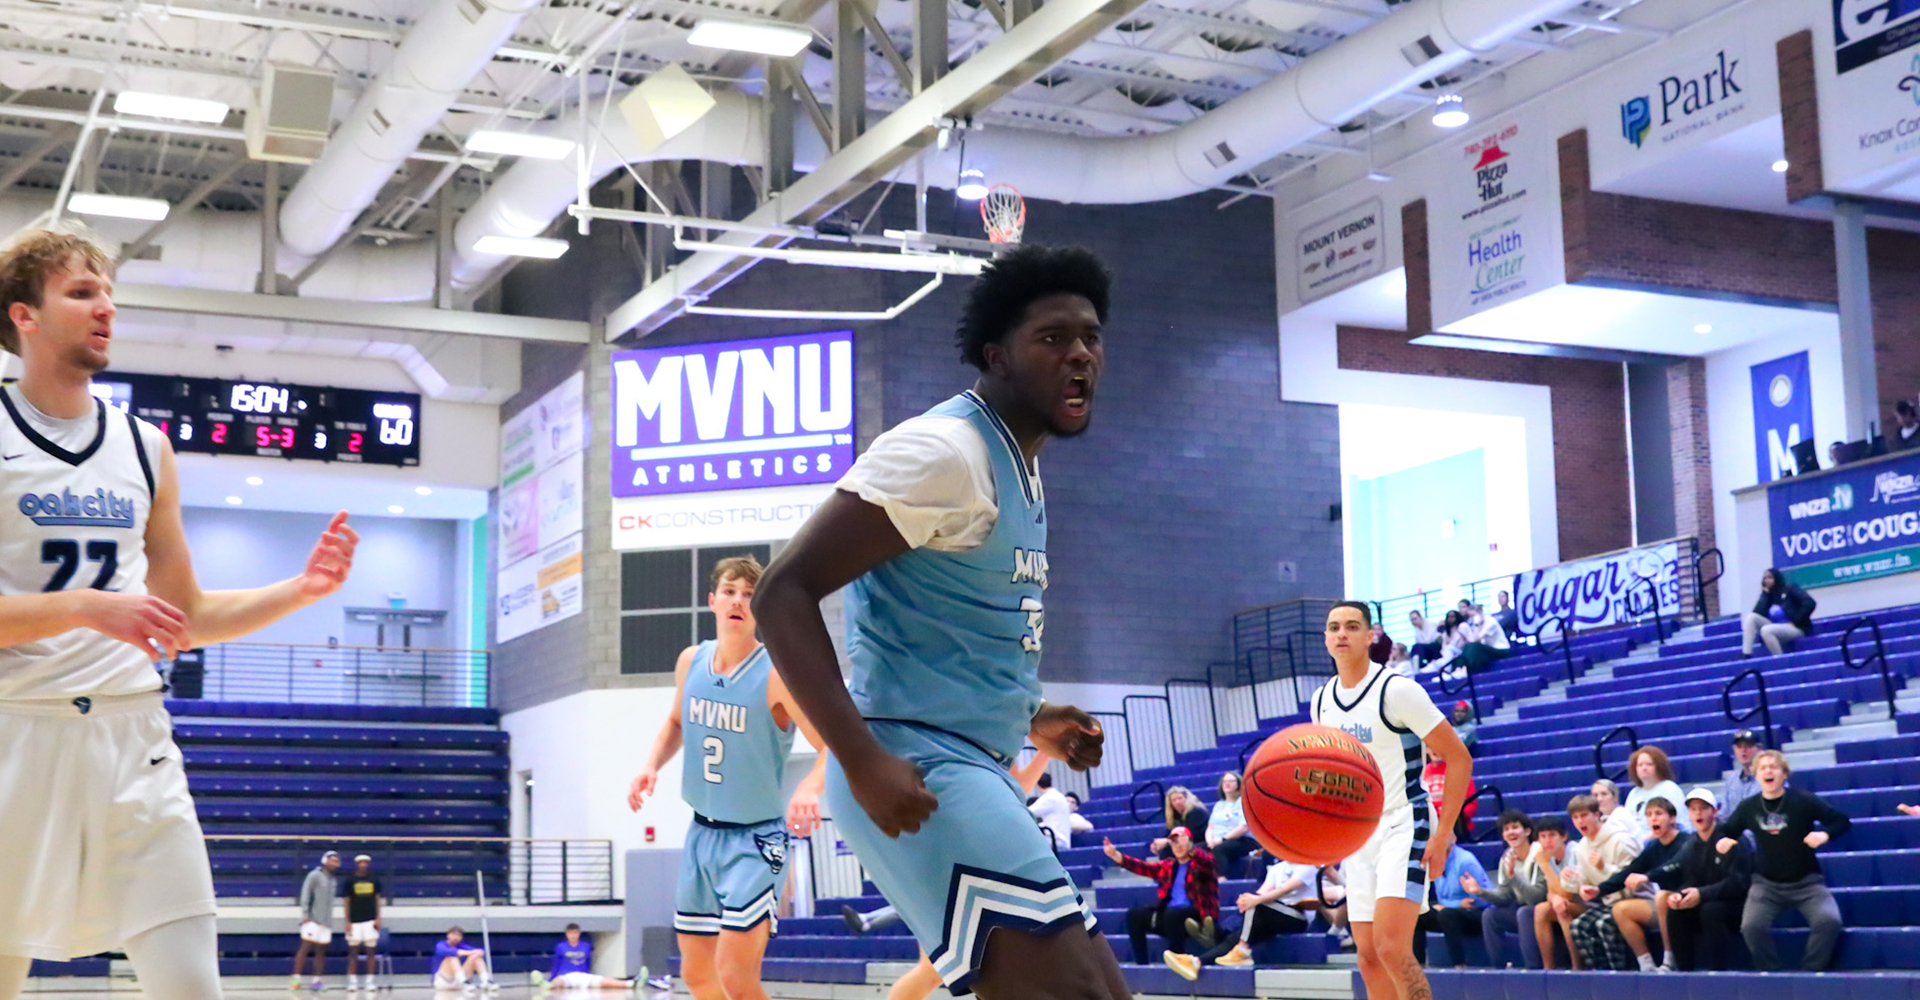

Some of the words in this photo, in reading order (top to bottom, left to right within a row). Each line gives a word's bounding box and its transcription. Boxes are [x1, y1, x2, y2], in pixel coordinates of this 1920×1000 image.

[1659, 50, 1743, 126] Park
[1859, 127, 1893, 151] Knox
[1477, 162, 1508, 188] Pizza
[1479, 181, 1503, 201] Hut
[1303, 231, 1335, 255] MOUNT
[1337, 214, 1375, 240] VERNON
[1469, 229, 1522, 267] Health
[1476, 254, 1525, 291] Center
[614, 340, 852, 447] MVNU
[179, 423, 193, 441] 3
[211, 423, 228, 444] 2
[314, 432, 327, 449] 3
[348, 432, 363, 453] 2
[379, 419, 413, 446] 60
[632, 453, 832, 486] ATHLETICS
[18, 486, 135, 529] oakcity
[1780, 525, 1846, 558] VOICE
[1852, 511, 1920, 544] COUG
[1513, 560, 1626, 637] Cougar
[688, 696, 748, 734] MVNU
[702, 734, 725, 784] 2
[1294, 765, 1373, 795] LEGACY
